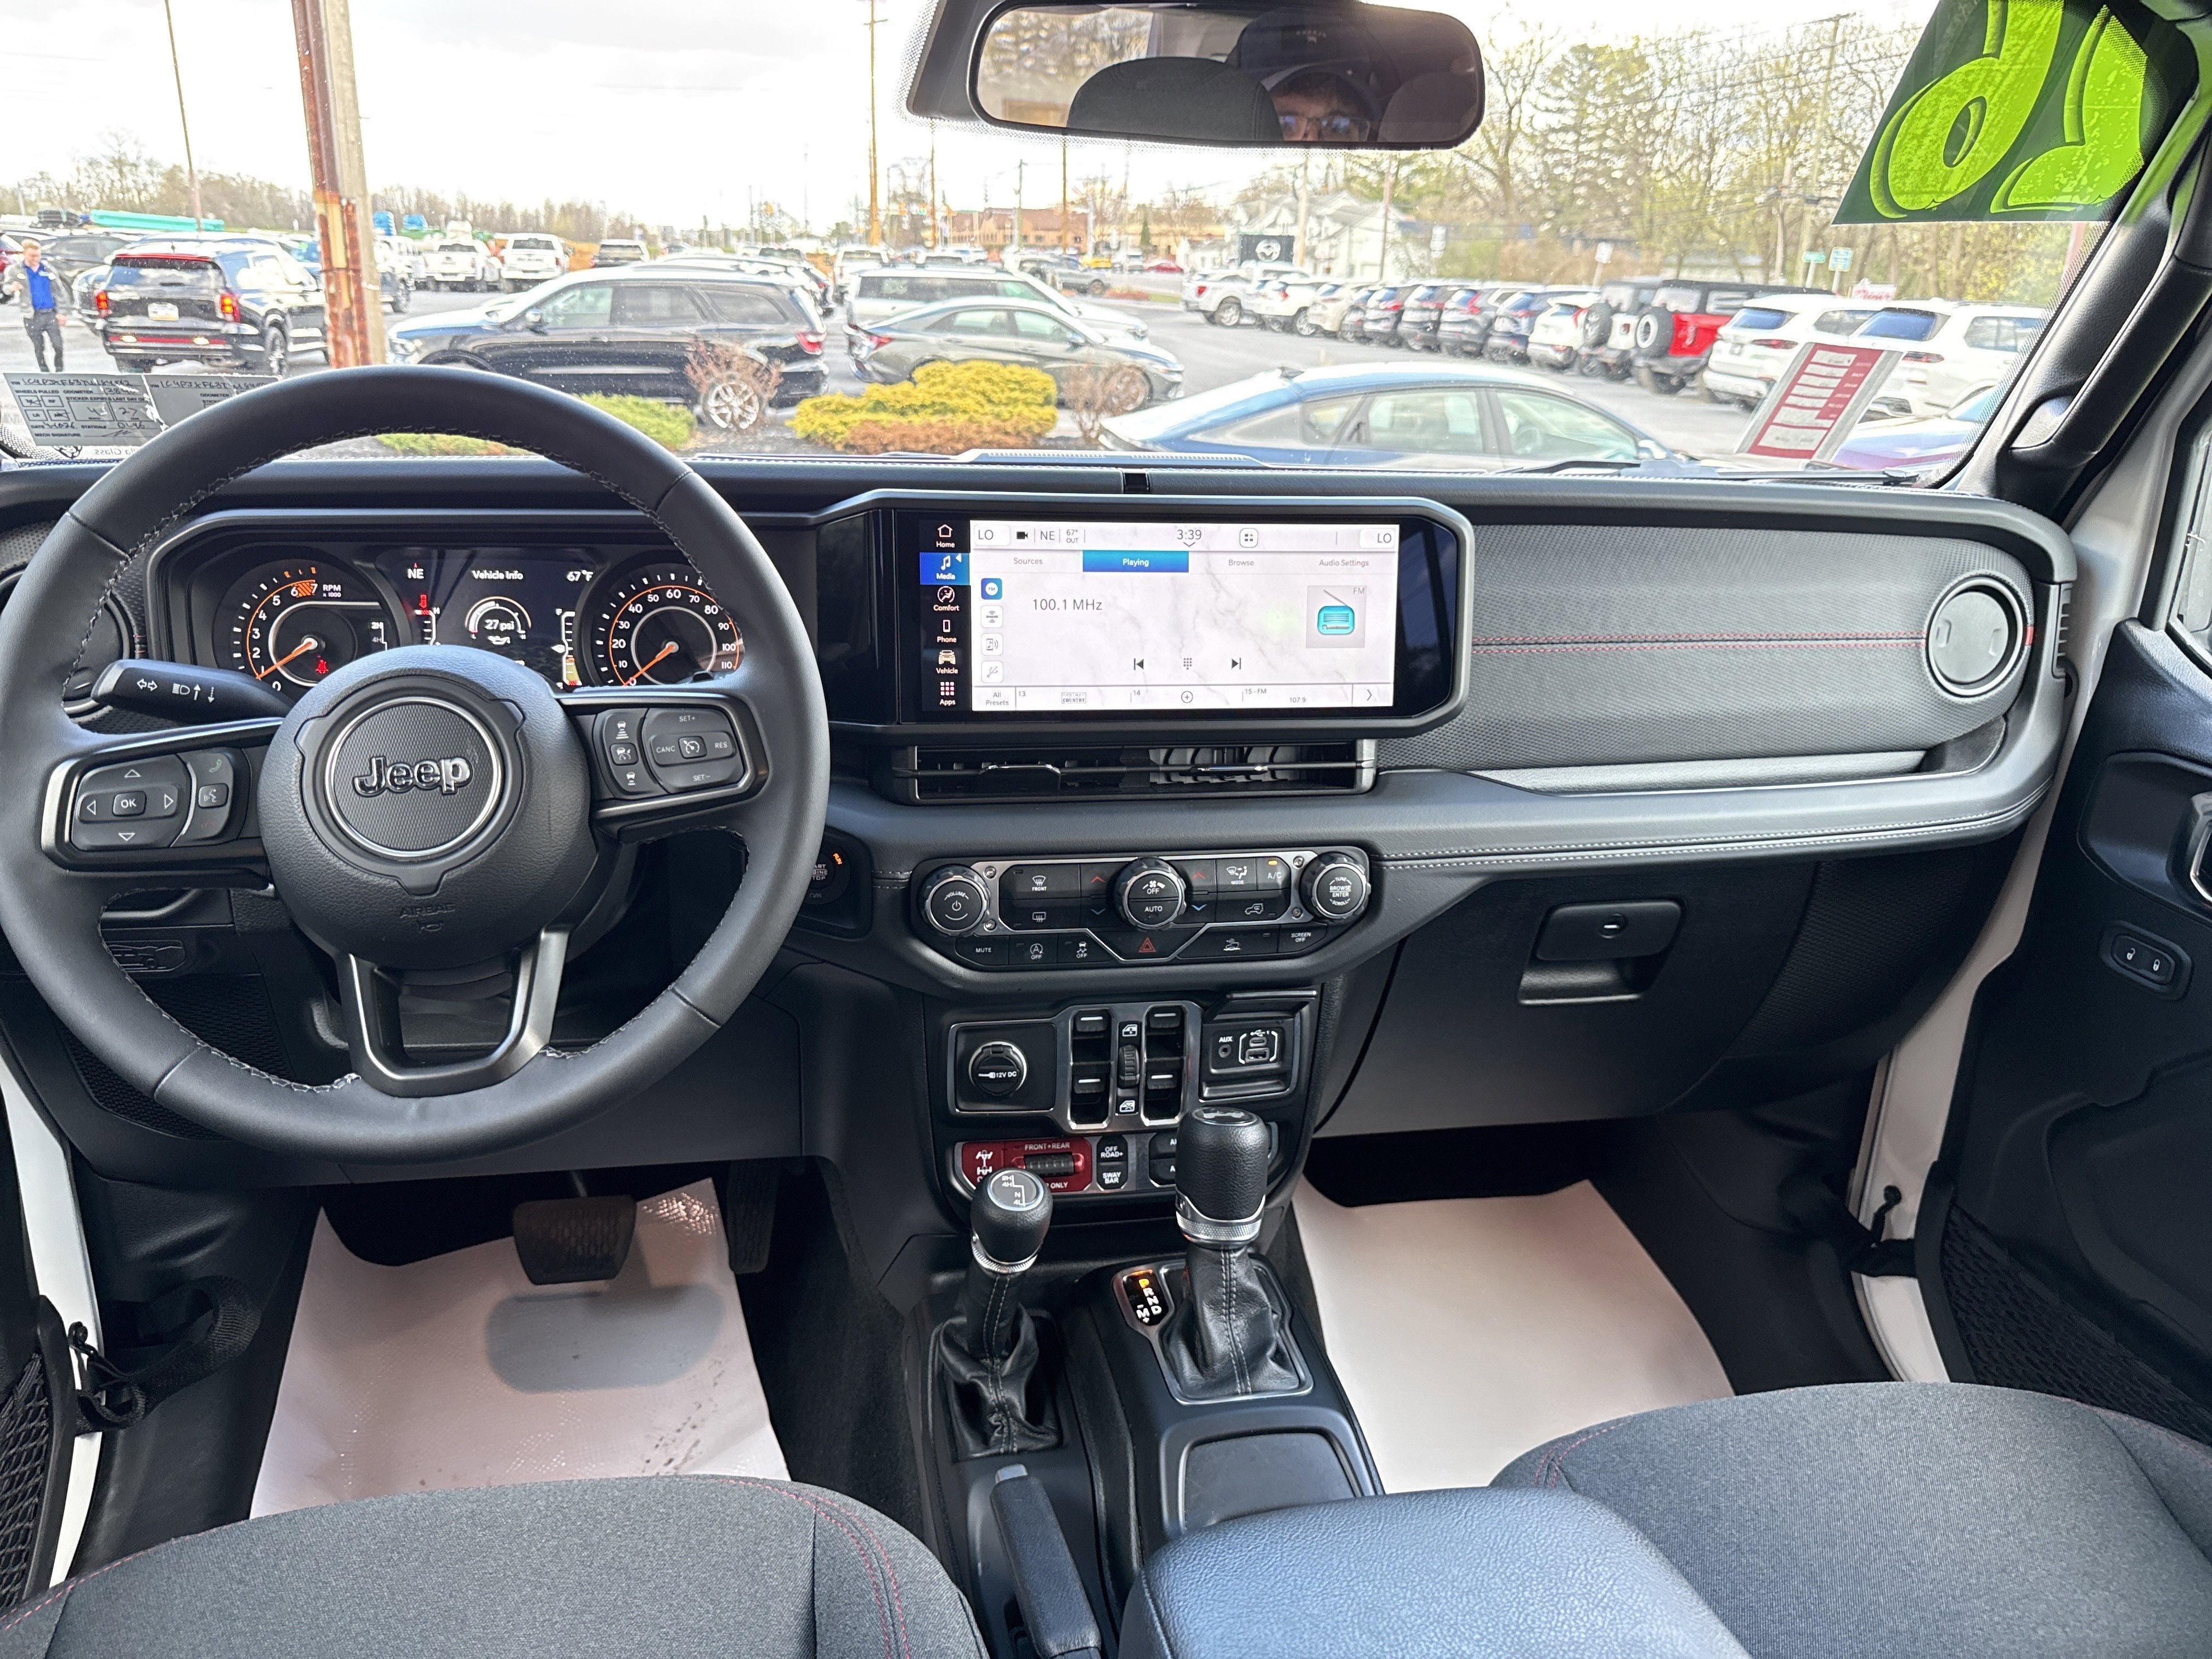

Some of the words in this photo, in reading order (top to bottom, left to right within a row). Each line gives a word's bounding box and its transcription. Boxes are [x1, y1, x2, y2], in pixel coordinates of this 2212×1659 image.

[978, 530, 994, 540] LO
[1040, 531, 1055, 540] NE
[1177, 529, 1202, 540] 3:39
[1377, 533, 1391, 544] LO
[1014, 557, 1042, 565] Sources
[1122, 558, 1149, 567] Playing
[1341, 559, 1369, 567] Settings
[407, 569, 424, 578] NE
[472, 571, 504, 580] Vehicle
[506, 570, 523, 580] Info
[567, 571, 594, 581] 67°F
[291, 586, 298, 597] 6
[311, 583, 318, 594] 7
[647, 594, 659, 603] 50
[666, 589, 681, 599] 60
[273, 595, 281, 606] 5
[1032, 599, 1067, 610] 100.1
[1073, 599, 1102, 610] MHz
[628, 605, 642, 613] 40
[704, 605, 718, 614] 80
[259, 610, 267, 620] 4
[485, 619, 499, 629] 27
[500, 621, 515, 631] psi
[718, 622, 729, 630] 90
[252, 628, 261, 639] 3
[612, 639, 626, 648] 20
[722, 644, 736, 652] 100
[252, 647, 261, 658] 2
[619, 660, 627, 669] 10
[273, 681, 281, 692] 0
[939, 698, 956, 707] Apps
[354, 757, 471, 797] Jeep
[121, 798, 137, 808] OK
[1268, 872, 1282, 881] A/C
[1139, 1278, 1149, 1289] P
[1143, 1288, 1154, 1297] R
[1147, 1296, 1159, 1306] N
[1136, 1308, 1150, 1319] M
[1151, 1306, 1162, 1315] D
